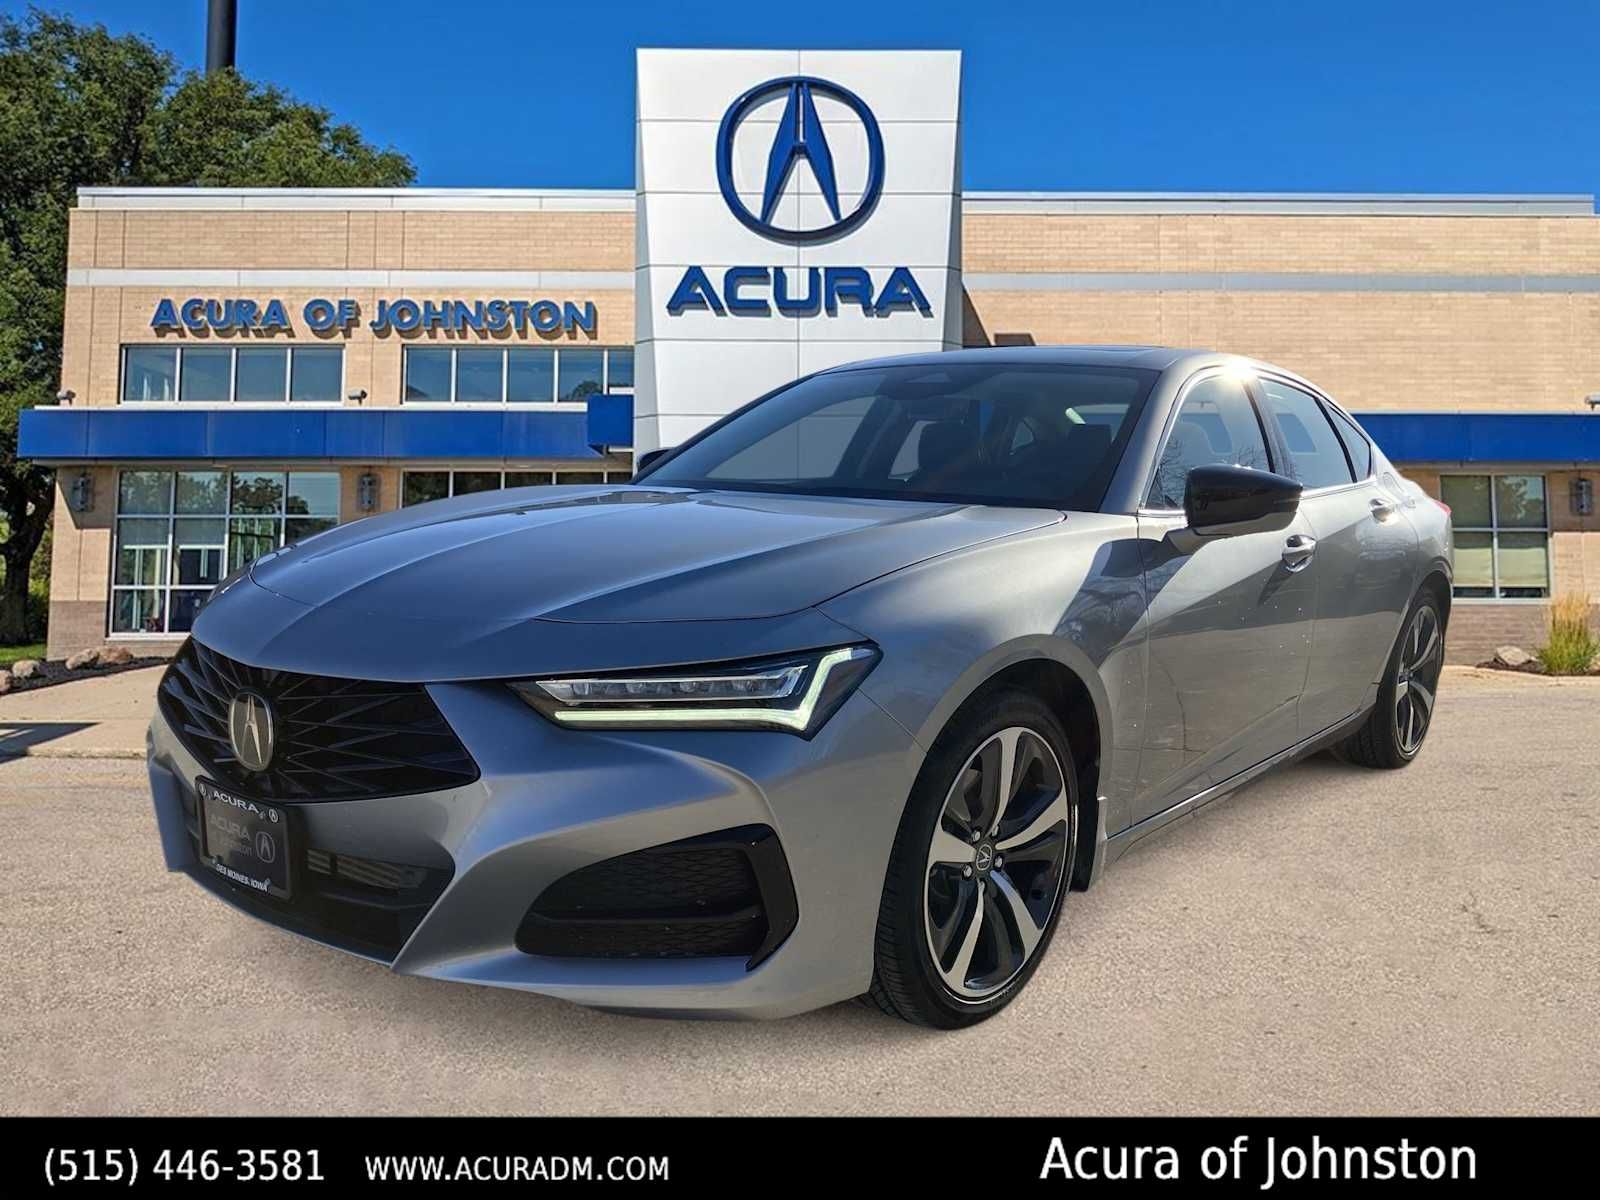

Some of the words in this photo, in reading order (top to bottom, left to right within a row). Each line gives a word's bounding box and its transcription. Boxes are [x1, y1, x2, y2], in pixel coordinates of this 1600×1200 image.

[666, 265, 934, 317] ACURA
[150, 298, 292, 331] ACURA
[303, 298, 357, 331] OF
[370, 299, 595, 332] JOHNSTON
[213, 790, 260, 814] ACURA
[250, 878, 268, 892] IOWA
